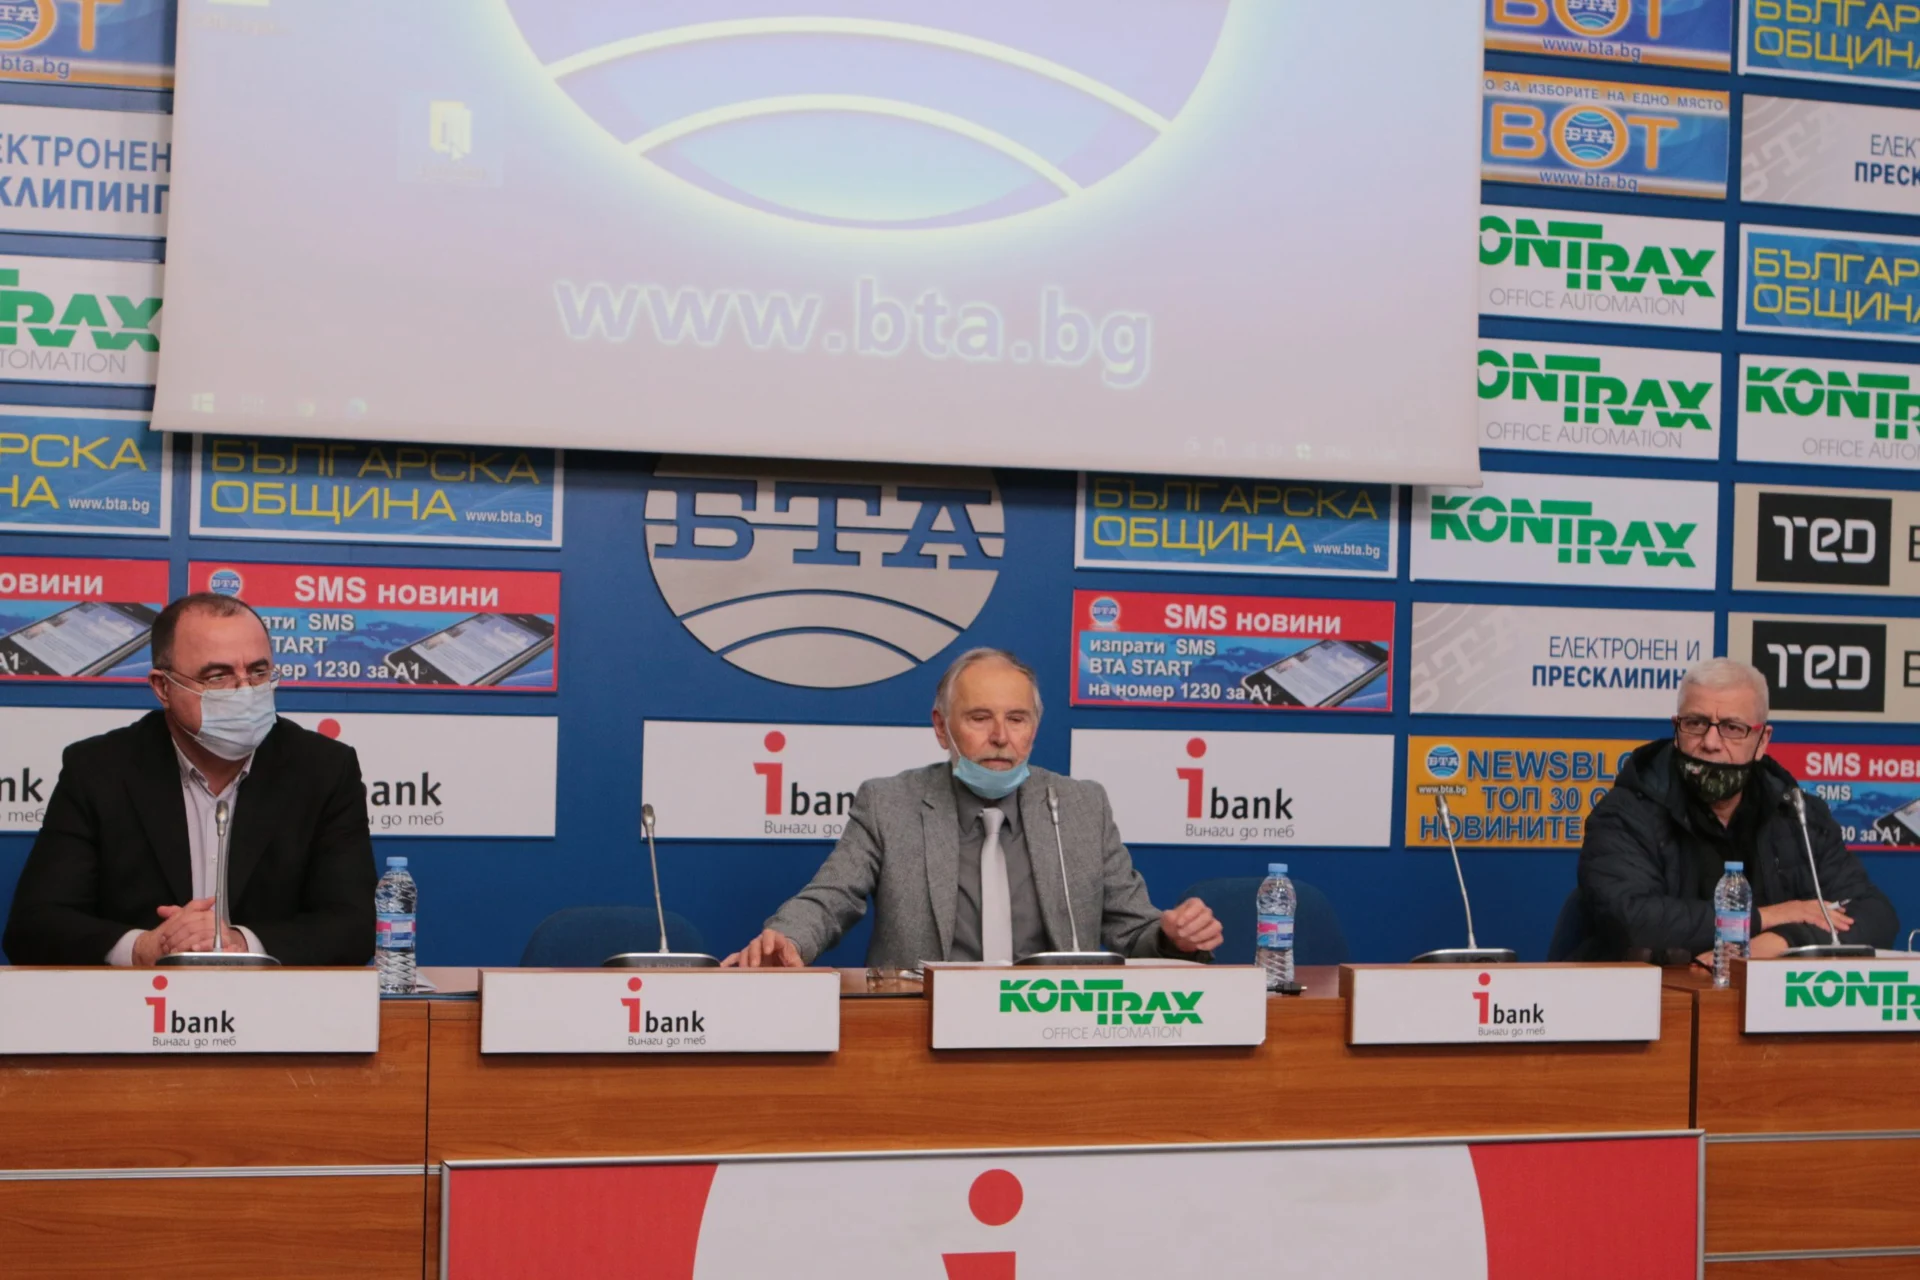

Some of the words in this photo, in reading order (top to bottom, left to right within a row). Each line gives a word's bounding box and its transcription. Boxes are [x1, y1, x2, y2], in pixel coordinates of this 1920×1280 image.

[1542, 37, 1641, 62] www.bta.bg
[1755, 26, 1920, 70] ОБЩИН
[1503, 80, 1520, 93] ЗА
[1528, 83, 1599, 100] ИЗБОРИТЕ
[1607, 91, 1625, 102] НА
[1633, 93, 1669, 107] ЕДНО
[1677, 96, 1723, 111] МЯСТО
[1489, 102, 1681, 170] ВОТ
[0, 133, 171, 173] КТРОНЕН
[1539, 171, 1638, 192] www.bta.bg
[1489, 288, 1554, 308] OFFICE
[1560, 293, 1685, 316] AUTOMATION
[1753, 283, 1920, 325] ОБЩИН
[553, 275, 1155, 388] www.bta.bg
[1486, 421, 1551, 442] OFFICE
[1557, 425, 1682, 449] AUTOMATION
[1802, 437, 1864, 457] OFFICE
[211, 440, 540, 484] БЪЛГАРСКА
[69, 496, 150, 514] www.bta.bg
[211, 480, 457, 525] ОБЩИНА
[465, 509, 543, 528] www.bta.bg
[1094, 477, 1378, 520] БЪЛГАРСКА
[653, 476, 1000, 570] БТА
[1430, 495, 1698, 568] KONTRAX
[1093, 516, 1306, 556] ОБЩИНА
[1313, 542, 1380, 558] www.bta.bg
[294, 575, 367, 603] SMS
[308, 613, 354, 631] SMS
[1164, 603, 1228, 629] SMS
[1176, 638, 1216, 656] SMS
[1550, 636, 1678, 661] ЕЛЕКТРОНЕН
[1687, 641, 1700, 661] И
[313, 660, 361, 679] 1230
[367, 666, 388, 679] за
[1131, 659, 1192, 677] START
[1089, 683, 1109, 697] на
[1116, 685, 1174, 701] номер
[1180, 682, 1221, 700] 1230
[1226, 687, 1245, 700] за
[1806, 752, 1861, 777] SMS
[1481, 786, 1540, 811] ТОП
[1550, 787, 1581, 811] 30
[408, 810, 444, 826] теб
[764, 820, 816, 834] Винаги
[1420, 816, 1582, 841] НОВИНИТЕ
[1185, 824, 1234, 837] Винаги
[1263, 824, 1295, 838] теб
[1860, 828, 1877, 841] за
[999, 979, 1204, 1025] KONTRAX
[152, 1036, 190, 1046] Винаги
[212, 1036, 237, 1047] теб
[628, 1036, 663, 1046] Винаги
[684, 1035, 706, 1046] теб
[1042, 1027, 1089, 1040] OFFICE
[1092, 1026, 1182, 1039] AUTOMATION
